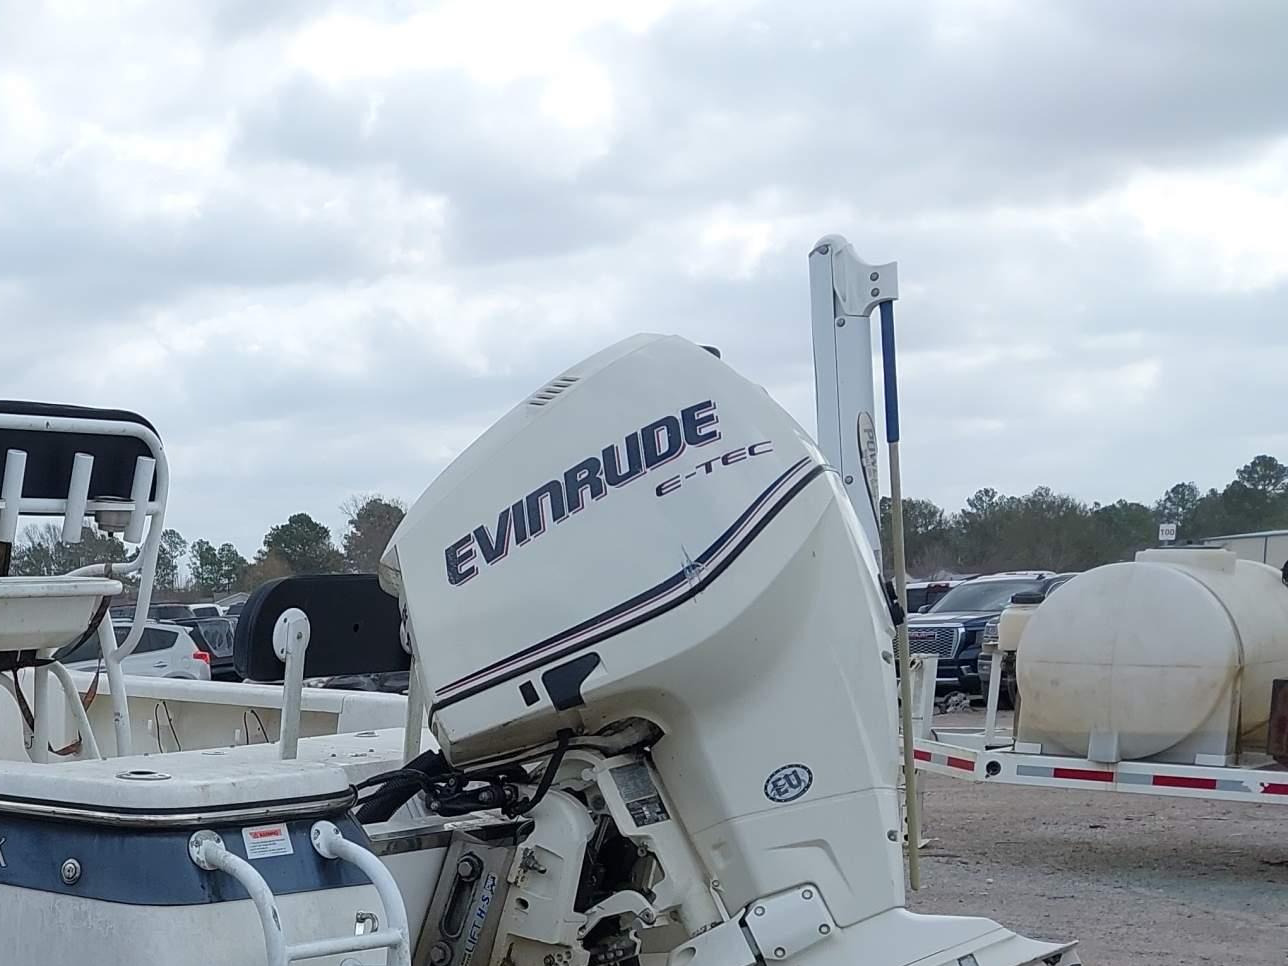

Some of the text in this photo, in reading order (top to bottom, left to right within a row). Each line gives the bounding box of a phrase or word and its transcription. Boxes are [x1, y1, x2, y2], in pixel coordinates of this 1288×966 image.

[444, 399, 722, 587] EVINRUDE
[655, 440, 774, 498] E-TEC
[464, 923, 482, 954] LIFT
